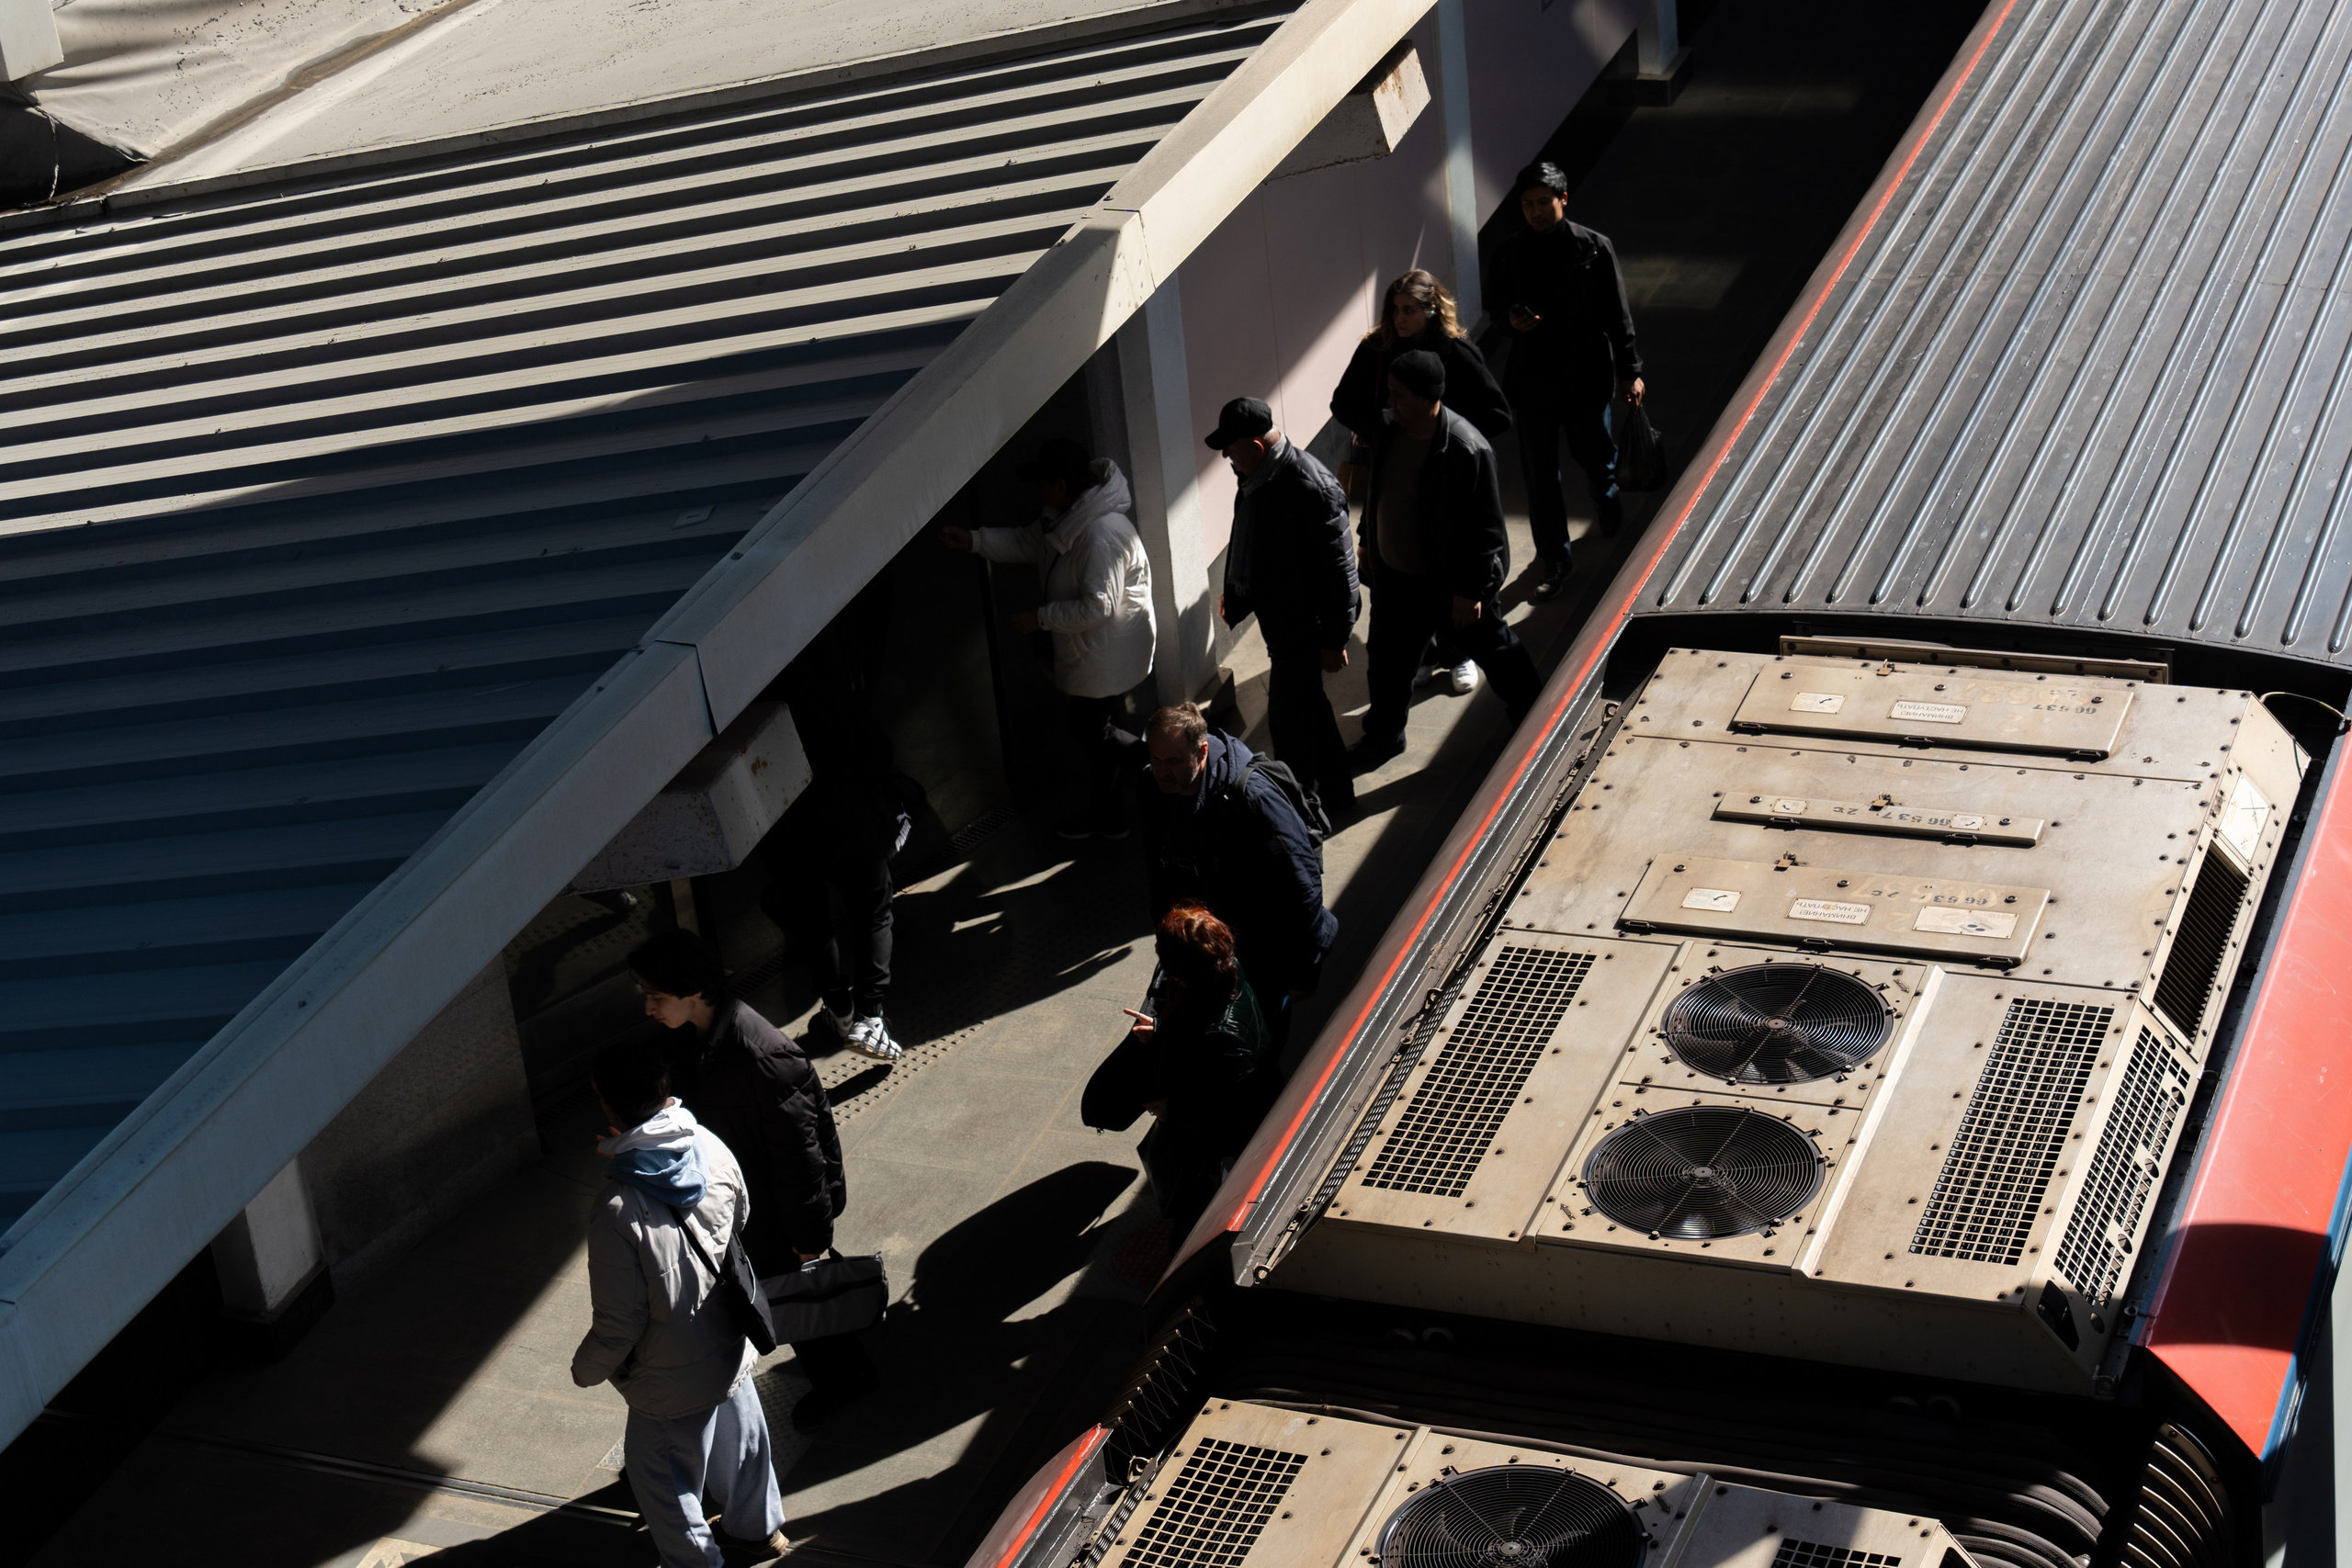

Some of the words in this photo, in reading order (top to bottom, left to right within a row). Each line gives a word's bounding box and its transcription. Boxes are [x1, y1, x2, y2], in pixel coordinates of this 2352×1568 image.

[1897, 704, 1950, 712] НАСТУПАТЬ
[1900, 711, 1954, 720] ВНИМАНИЕ!
[1797, 902, 1852, 911] НАСТУПАТЬ
[1800, 910, 1857, 920] ВНИМАНИЕ!
